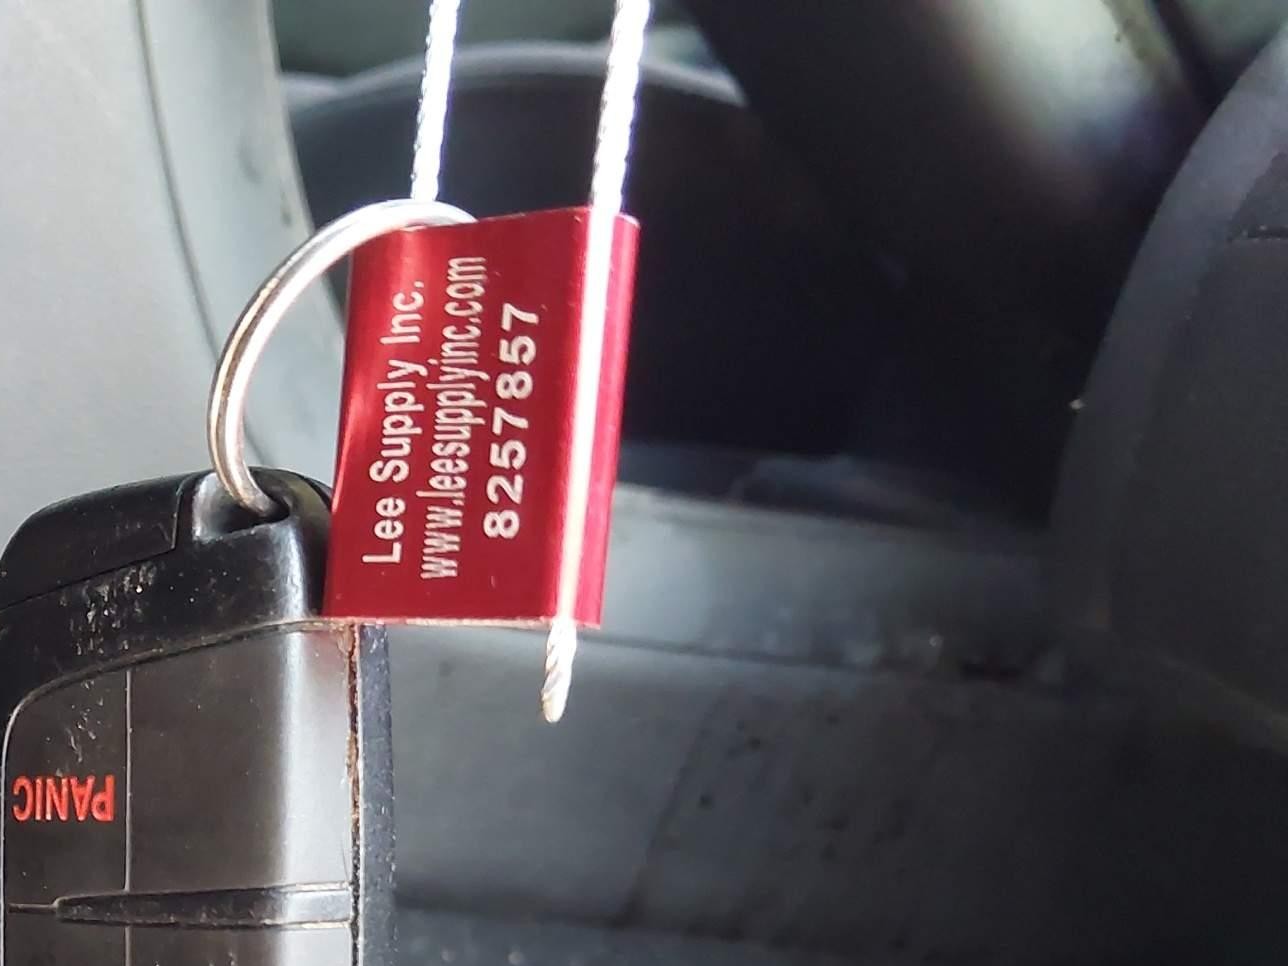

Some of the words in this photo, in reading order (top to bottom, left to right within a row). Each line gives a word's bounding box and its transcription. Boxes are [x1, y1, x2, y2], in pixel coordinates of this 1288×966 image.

[380, 280, 425, 345] Inc.
[369, 358, 428, 484] Supply
[416, 256, 489, 580] www.leesupplyinc.com
[483, 302, 540, 540] 8257857
[363, 495, 406, 565] Lee
[12, 774, 115, 822] PANIC
